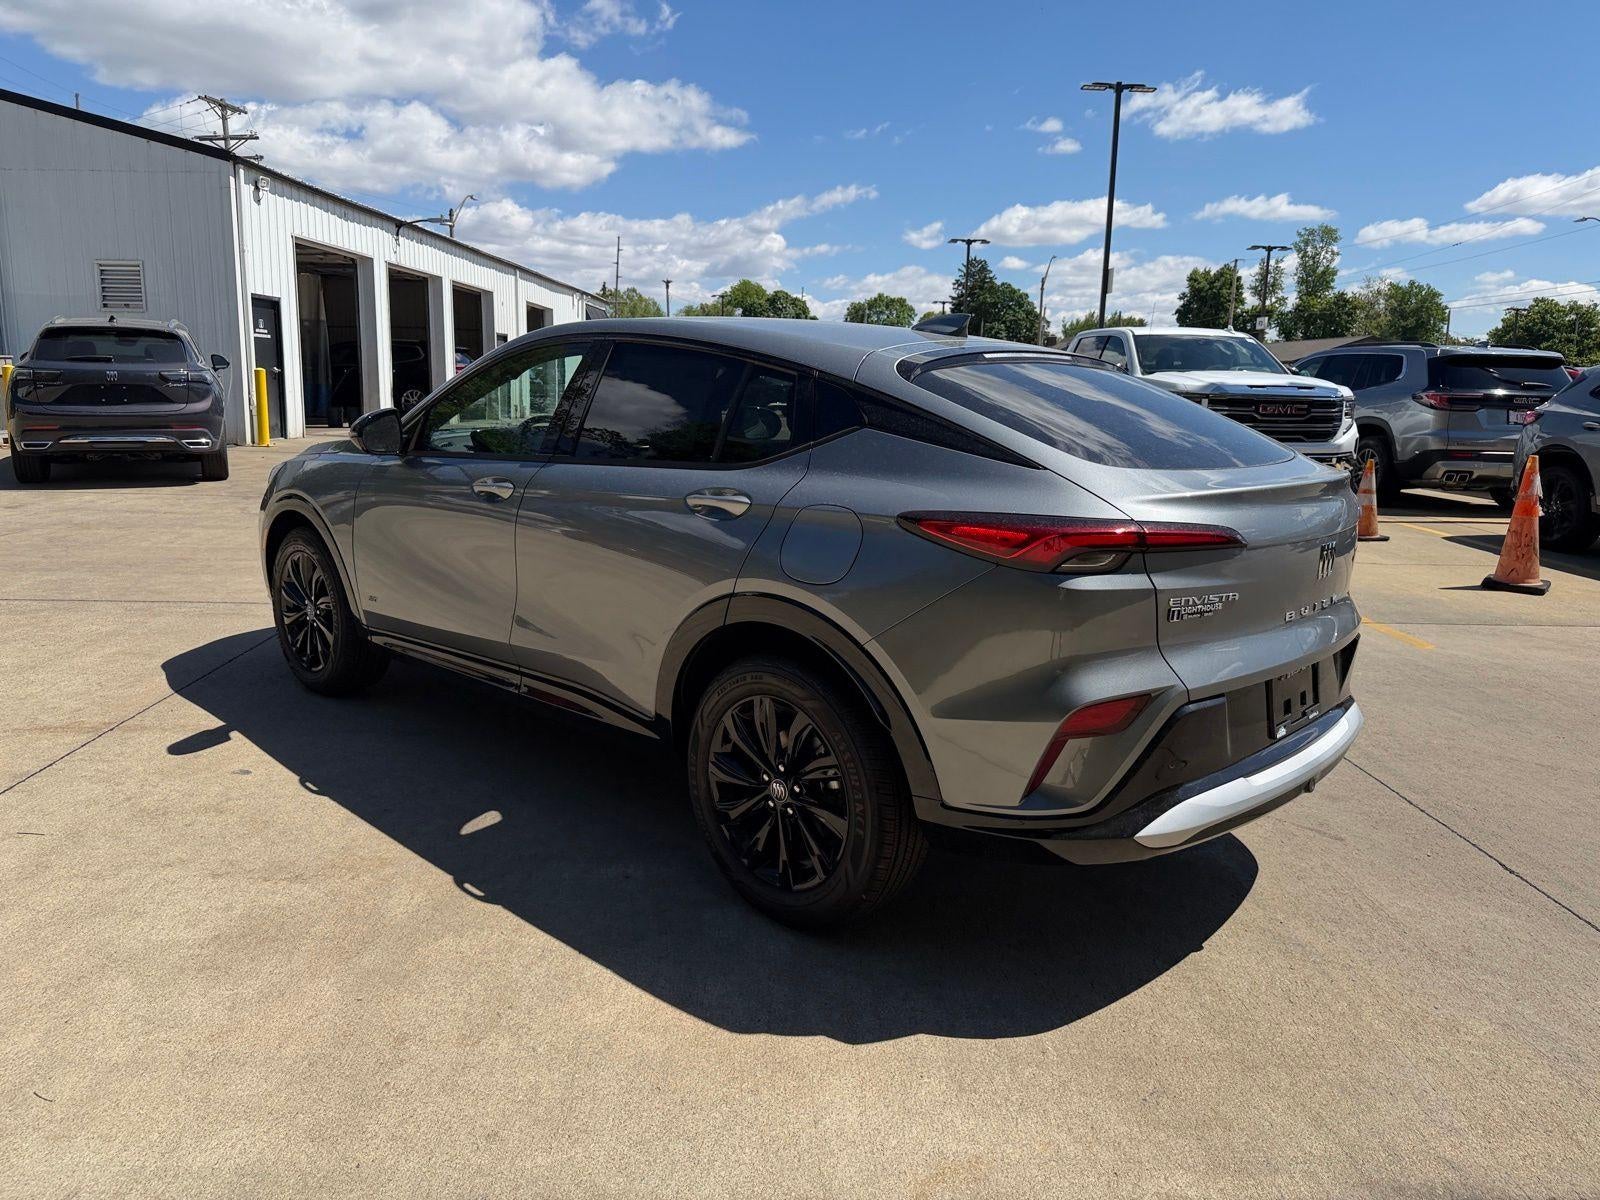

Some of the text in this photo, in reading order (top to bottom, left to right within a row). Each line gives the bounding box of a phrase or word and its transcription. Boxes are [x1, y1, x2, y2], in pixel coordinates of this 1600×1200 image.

[1259, 403, 1309, 415] GMC
[1169, 592, 1240, 607] ENVISTA
[1181, 602, 1224, 615] LIGHTHOUSE
